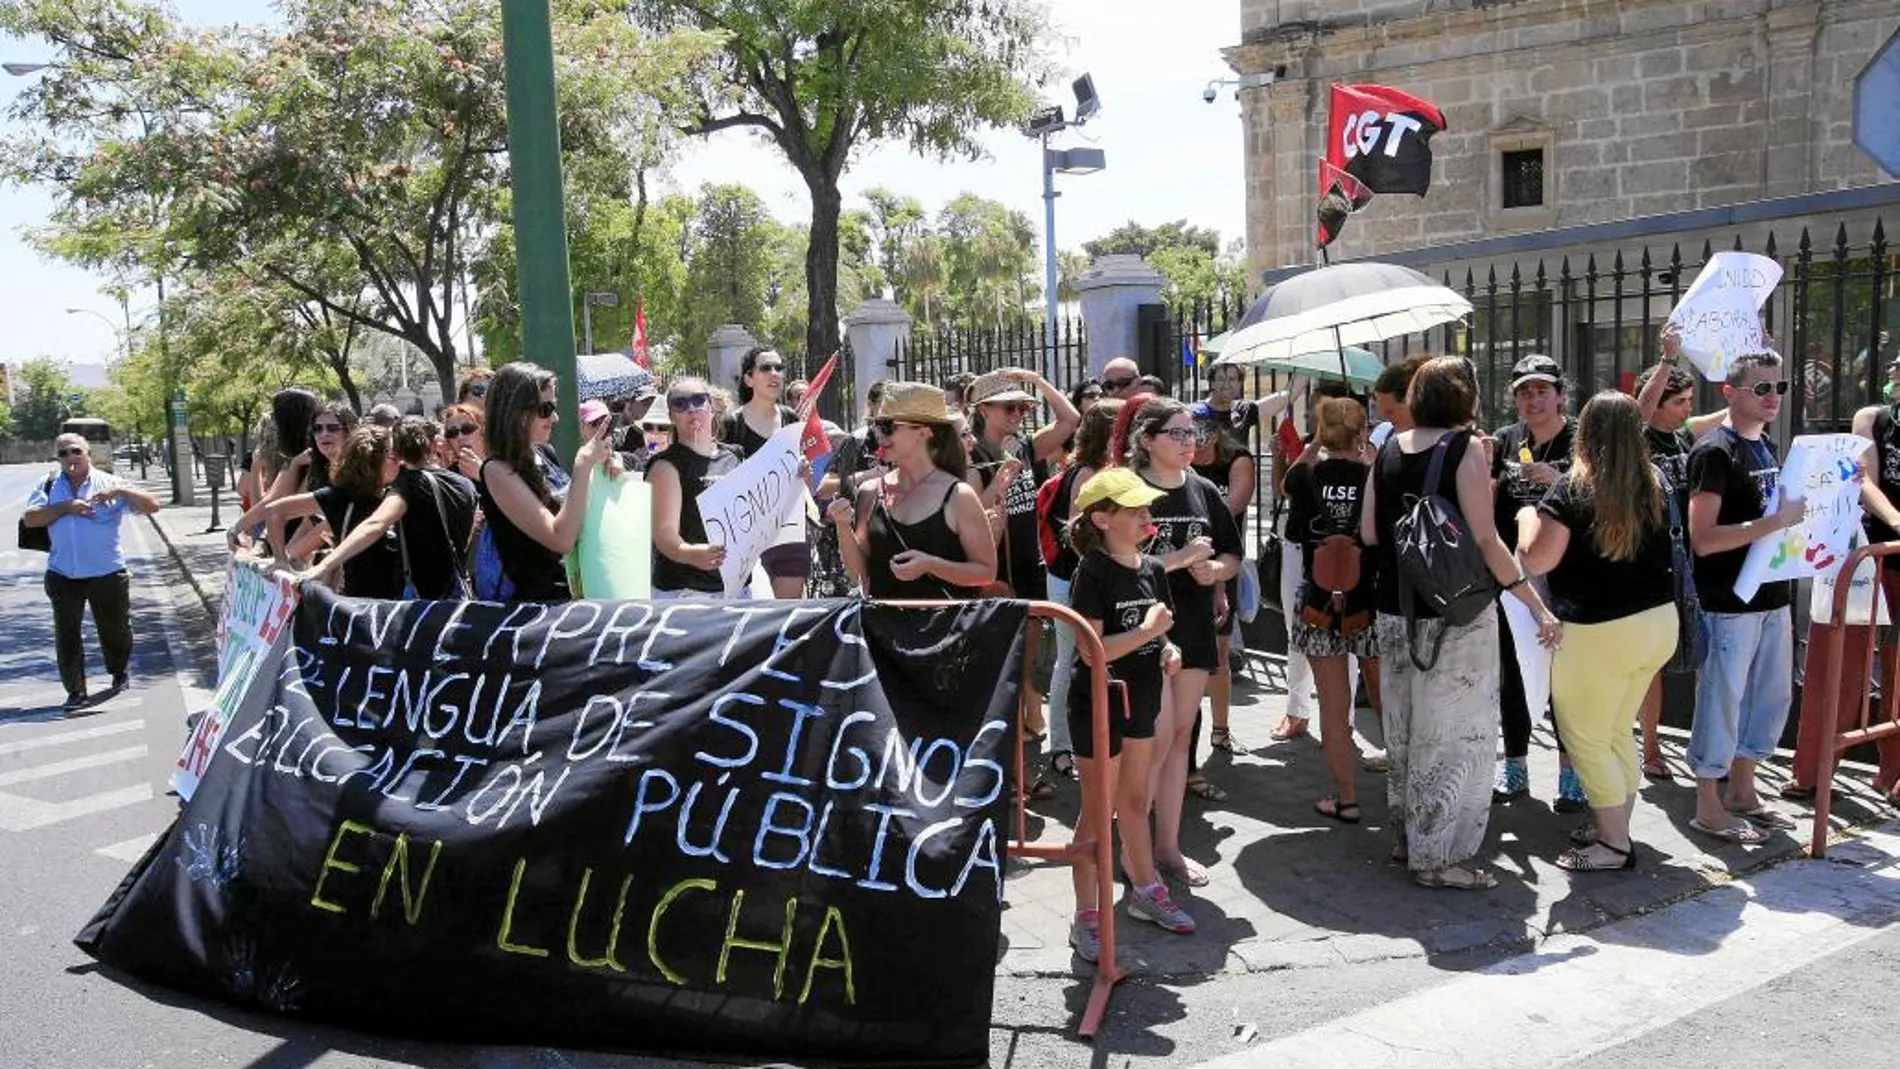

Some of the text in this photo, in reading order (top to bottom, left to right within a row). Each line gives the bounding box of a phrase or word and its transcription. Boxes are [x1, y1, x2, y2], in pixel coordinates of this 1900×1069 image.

[1342, 110, 1422, 158] CGT
[1322, 485, 1357, 500] ILSE
[319, 599, 878, 689] INTERPRETES
[332, 664, 543, 754] LENGUA
[566, 692, 671, 763] DE
[694, 692, 1009, 809] SIGNOS
[225, 703, 571, 830] EDUCACIÓN
[624, 768, 1005, 901] PÚBLICA
[311, 819, 857, 1007] EN LUCHA
